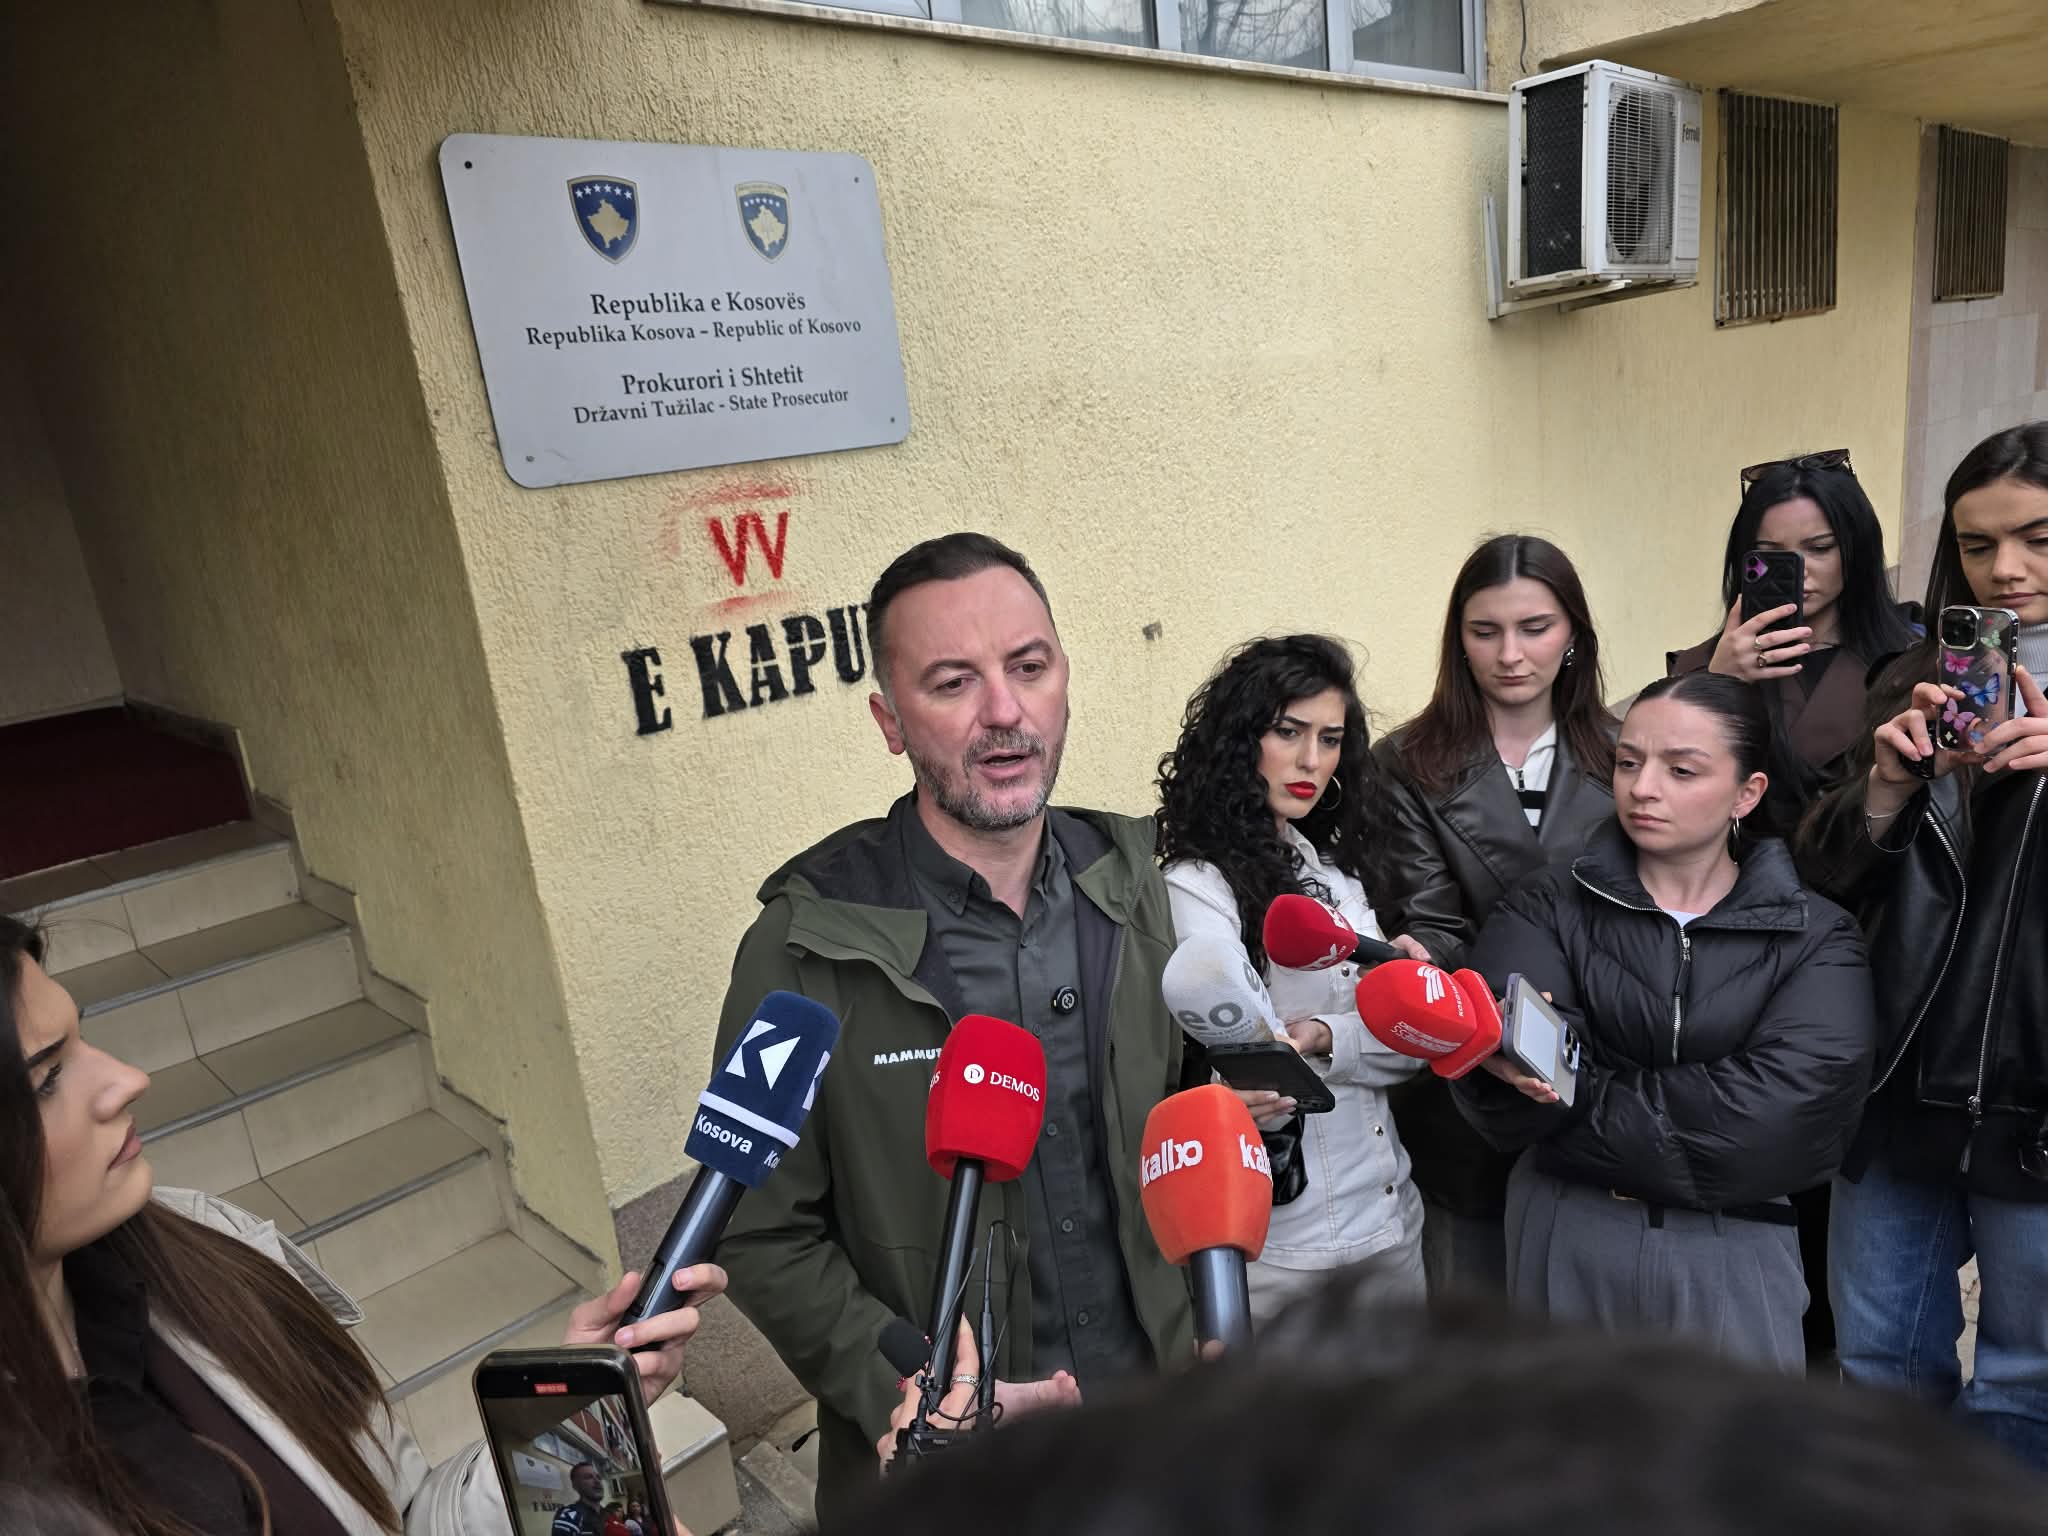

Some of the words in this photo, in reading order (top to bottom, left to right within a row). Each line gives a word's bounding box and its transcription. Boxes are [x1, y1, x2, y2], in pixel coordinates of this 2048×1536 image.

[590, 291, 705, 320] Republika
[711, 297, 721, 311] e
[726, 291, 806, 311] Kosovës
[526, 324, 627, 349] Republika
[631, 323, 695, 341] Kosova
[713, 319, 784, 342] Republic
[788, 318, 802, 335] of
[807, 317, 861, 335] Kosovo
[622, 368, 724, 395] Prokurori
[729, 368, 736, 387] i
[741, 364, 804, 387] Shtetit
[573, 401, 648, 423] Državni
[651, 397, 715, 417] Tužilac
[729, 394, 768, 411] State
[771, 389, 848, 408] Prosecutor
[620, 645, 673, 736] E
[688, 601, 873, 719] KAPU
[874, 1048, 942, 1065] MAMMUT
[990, 1071, 1040, 1101] DEMOS
[695, 1113, 753, 1154] Kosova
[1141, 1138, 1203, 1188] kallxo
